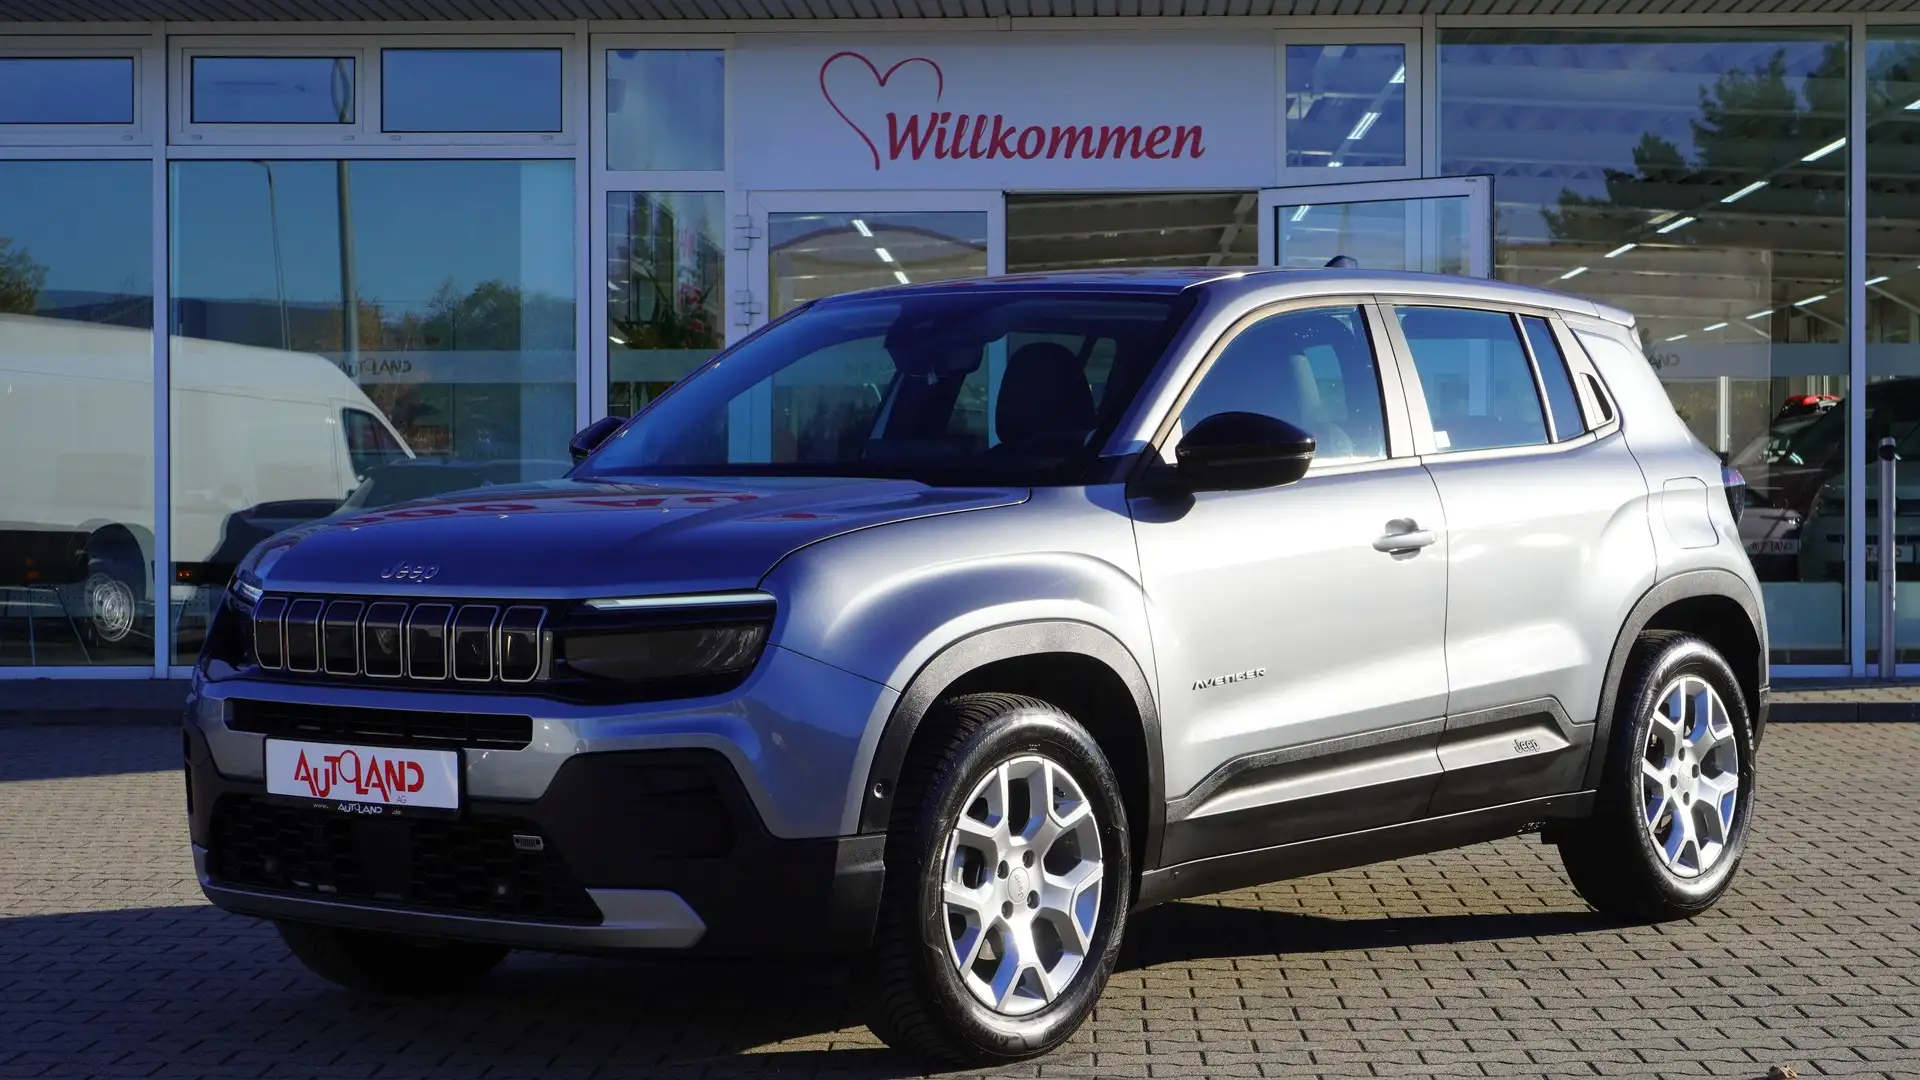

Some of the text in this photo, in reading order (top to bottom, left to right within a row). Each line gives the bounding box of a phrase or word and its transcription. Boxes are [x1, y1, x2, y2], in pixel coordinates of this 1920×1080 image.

[886, 111, 1205, 160] Willkommen
[380, 560, 440, 583] Jeep
[1191, 667, 1266, 691] AVENGER
[1513, 739, 1540, 754] Jeep
[294, 748, 425, 803] AUTOLAND
[337, 803, 383, 815] AUTOLAND
[396, 795, 407, 804] AG
